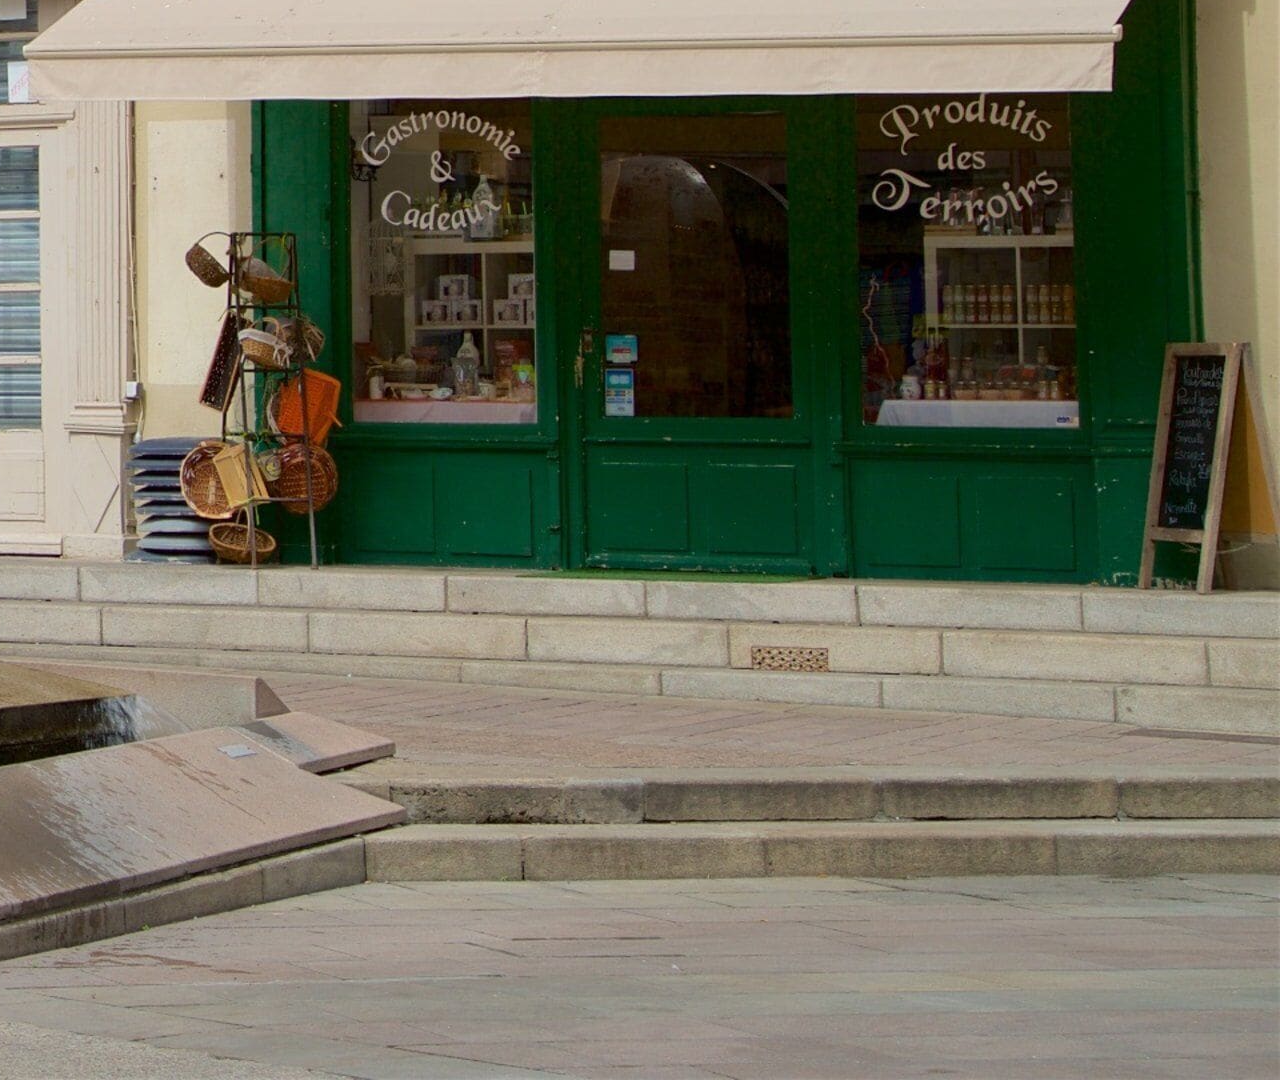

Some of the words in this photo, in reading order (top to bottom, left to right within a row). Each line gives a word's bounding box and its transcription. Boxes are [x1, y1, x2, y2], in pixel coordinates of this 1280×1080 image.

[360, 110, 521, 166] Gastronomie
[879, 92, 1053, 157] Produits
[430, 150, 456, 183] &
[937, 142, 987, 171] des
[380, 190, 502, 231] Cadeaux
[871, 168, 1059, 223] Terroirs
